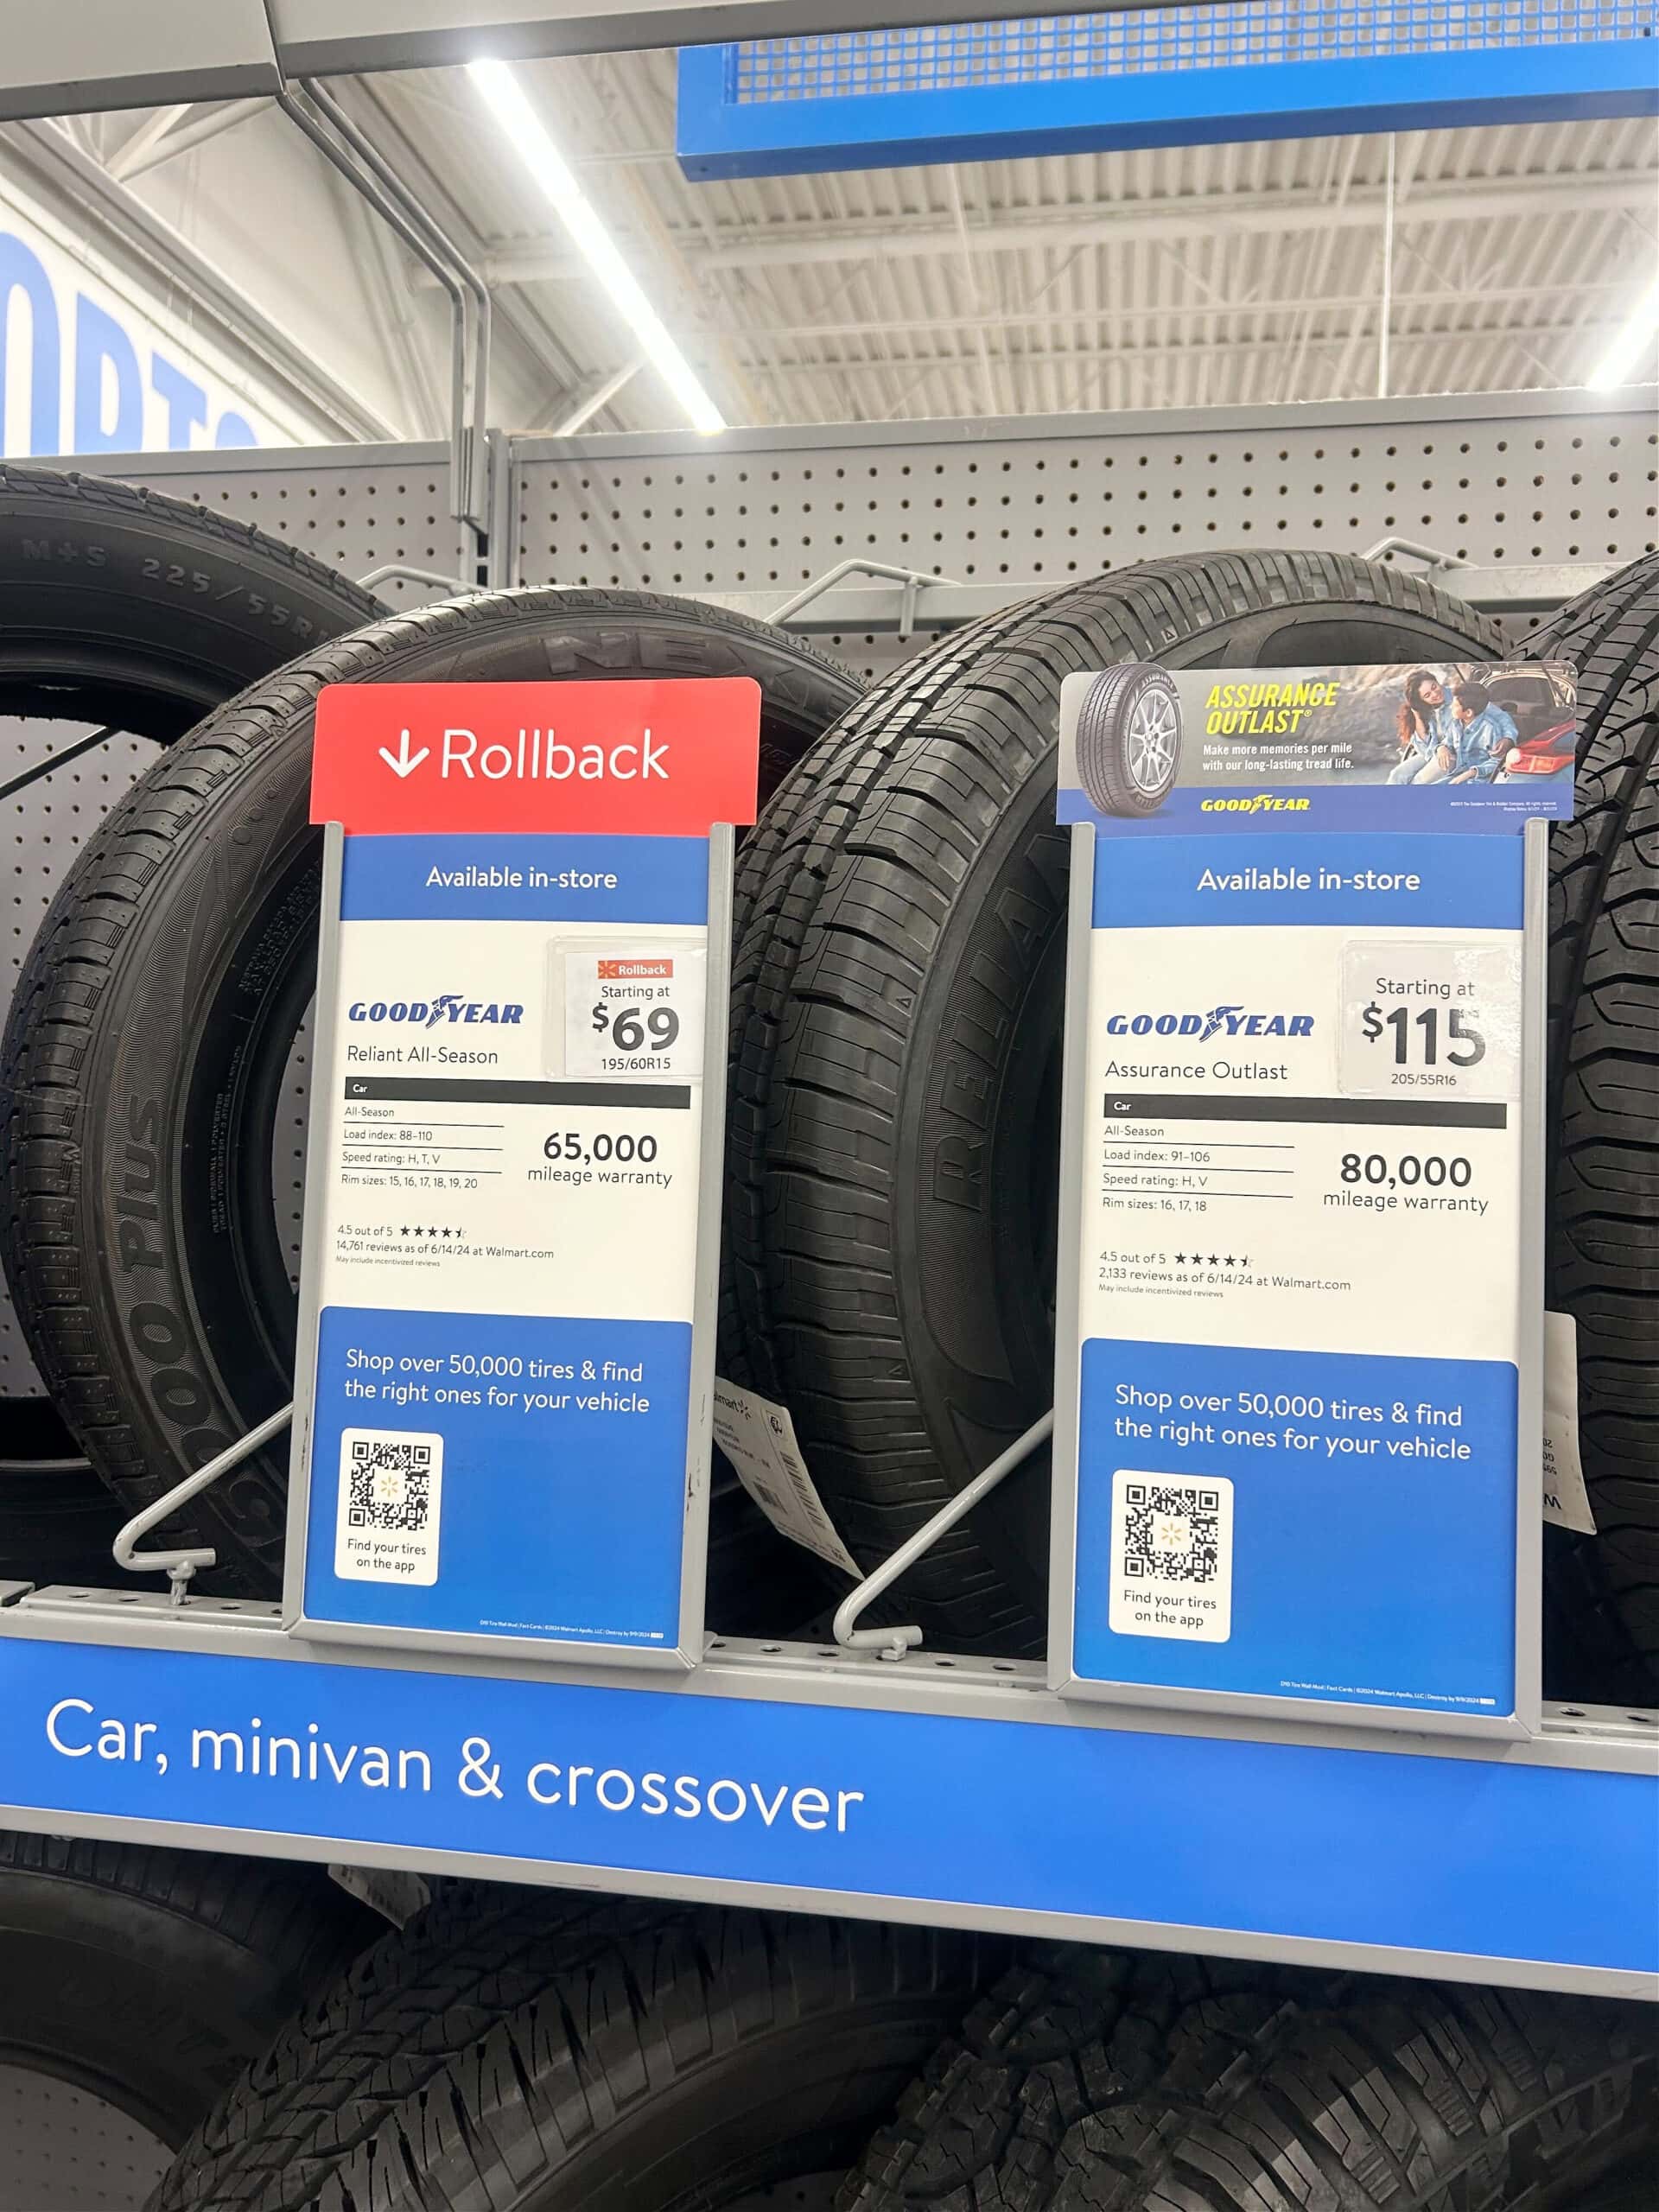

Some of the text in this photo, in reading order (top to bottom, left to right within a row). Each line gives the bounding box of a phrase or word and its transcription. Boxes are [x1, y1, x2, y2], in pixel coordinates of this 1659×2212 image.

[1205, 683, 1339, 708] ASSURANCE
[442, 729, 669, 779] Rollback
[1203, 742, 1352, 757] Make more memories per mile
[1203, 758, 1354, 772] with our long-lasting tread life.
[1201, 798, 1310, 812] GOODYEAR
[426, 866, 617, 888] Available in-store
[1198, 868, 1420, 891] Available in-store
[619, 963, 667, 976] Rollback
[602, 986, 670, 1000] Starting at
[1376, 978, 1474, 1000] Starting at
[348, 1001, 524, 1026] GOODYEAR
[593, 1002, 678, 1051] $69
[1107, 1013, 1314, 1039] GOODYEAR
[1363, 1001, 1486, 1068] $115
[348, 1046, 497, 1063] Reliant All-Season
[602, 1058, 670, 1070] 195/60R15
[1105, 1061, 1287, 1079] Assurance Outlast
[1392, 1074, 1456, 1085] 205/55R16
[353, 1084, 368, 1094] Car
[345, 1107, 394, 1116] All-Season
[1114, 1101, 1131, 1111] Car
[344, 1129, 432, 1141] Load index: 88-110
[1104, 1125, 1164, 1136] All-Season
[544, 1133, 657, 1165] 65,000
[1105, 1149, 1210, 1161] Load index: 91-106
[343, 1152, 440, 1166] Speed rating: H, T, V
[529, 1166, 672, 1189] mileage warranty
[1341, 1154, 1471, 1189] 80,000
[342, 1174, 359, 1184] Rim
[390, 1176, 401, 1186] 15,
[405, 1177, 416, 1187] 16,
[420, 1177, 430, 1187] 17,
[434, 1178, 446, 1188] 18,
[465, 1179, 477, 1188] 20
[1103, 1173, 1207, 1188] Speed rating: H, V
[1103, 1198, 1206, 1211] Rim sizes: 16, 17, 18
[1325, 1191, 1488, 1216] mileage warranty
[338, 1225, 352, 1234] 4.5
[374, 1226, 385, 1236] of
[387, 1227, 392, 1236] 5
[337, 1241, 363, 1250] 14,761
[418, 1244, 429, 1253] of
[431, 1244, 469, 1255] 6/14/24
[486, 1247, 553, 1258] Walmart.com
[1100, 1251, 1117, 1262] 4.5
[1143, 1254, 1156, 1263] of
[1160, 1254, 1166, 1264] 5
[1099, 1268, 1126, 1279] 2,133
[1130, 1270, 1173, 1281] reviews
[1192, 1273, 1205, 1282] of
[1207, 1274, 1253, 1285] 6/14/24
[1272, 1276, 1351, 1290] Walmart.com
[1099, 1284, 1114, 1293] May
[346, 1349, 642, 1382] Shop over 50,000 tires & find
[345, 1379, 649, 1413] the right ones for your vehicle
[1116, 1384, 1461, 1426] Shop over 50,000 tires & find
[1115, 1416, 1471, 1459] the right ones for your vehicle
[348, 1539, 426, 1554] Find your tires
[374, 1558, 391, 1568] the
[395, 1562, 415, 1573] app
[1124, 1590, 1216, 1609] Find your tires
[1135, 1611, 1203, 1629] on the app
[47, 1699, 864, 1831] Car, minivan & crossover
